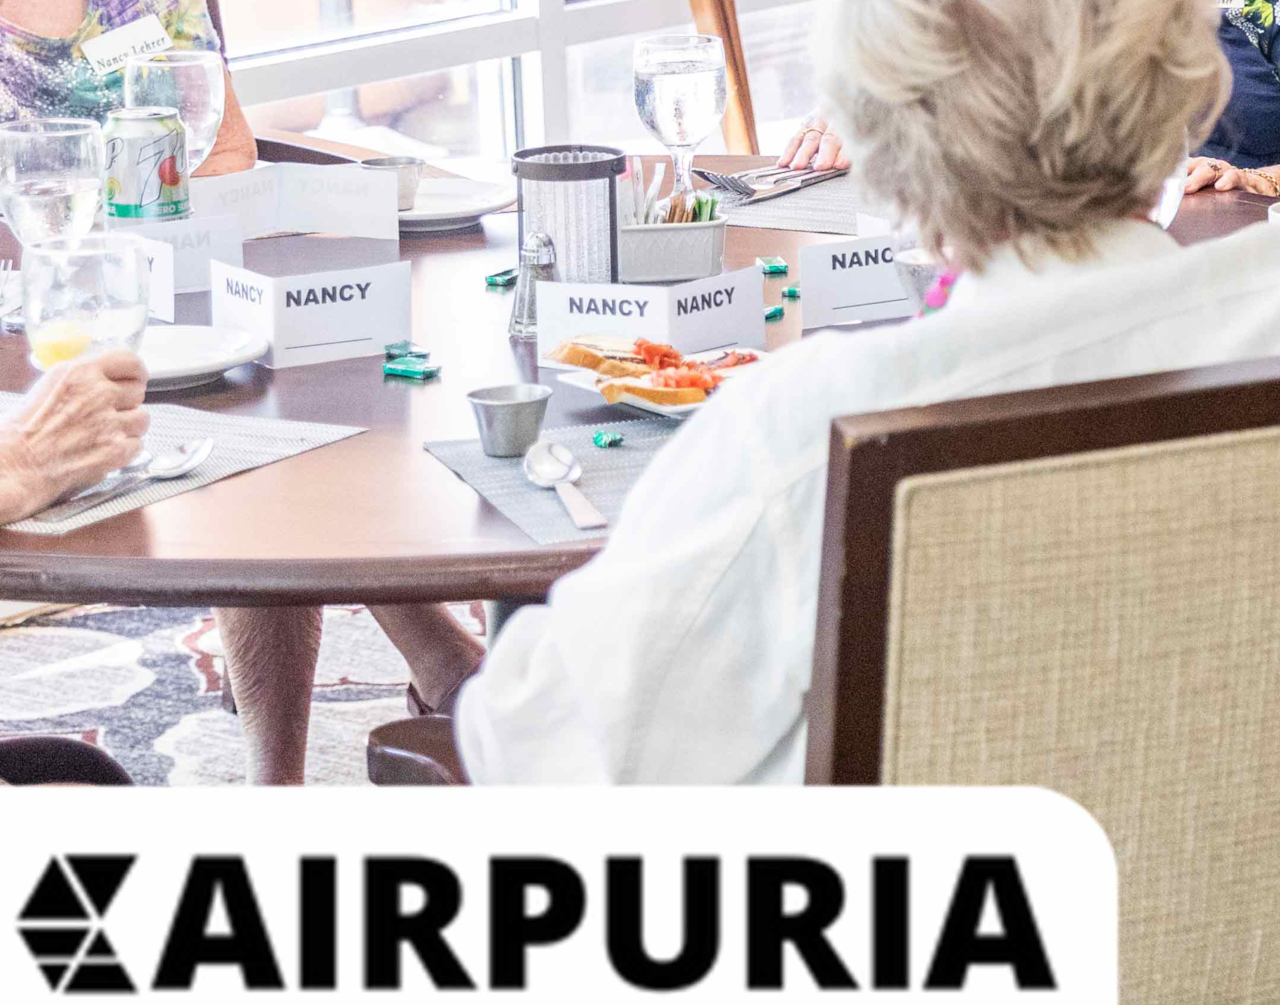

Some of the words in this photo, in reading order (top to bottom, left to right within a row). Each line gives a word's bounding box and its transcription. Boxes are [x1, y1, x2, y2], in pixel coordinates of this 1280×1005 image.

[131, 36, 166, 55] Lehrer
[831, 247, 893, 270] NANC
[225, 276, 264, 304] NANCY
[285, 282, 372, 308] NANCY
[677, 287, 736, 316] NANCY
[569, 296, 649, 317] NANCY
